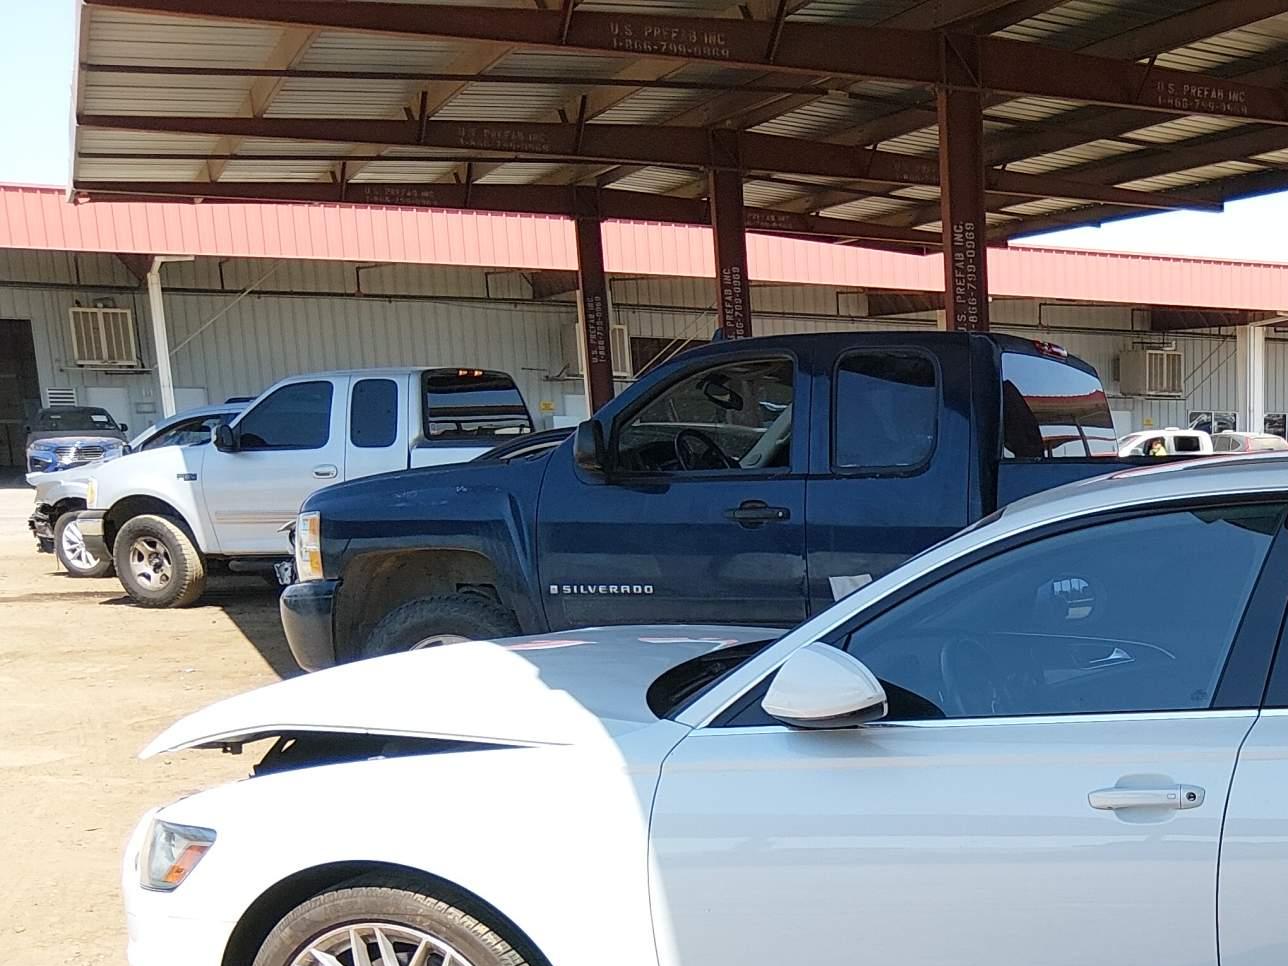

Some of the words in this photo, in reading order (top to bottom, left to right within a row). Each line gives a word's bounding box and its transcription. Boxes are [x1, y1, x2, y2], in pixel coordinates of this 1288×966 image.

[1184, 85, 1224, 100] PREFAB
[953, 221, 964, 246] INC.
[954, 252, 966, 304] PREFAB
[965, 222, 977, 329] -866-799-0969
[724, 289, 735, 327] PREFAB
[562, 584, 654, 594] SILVERADO
